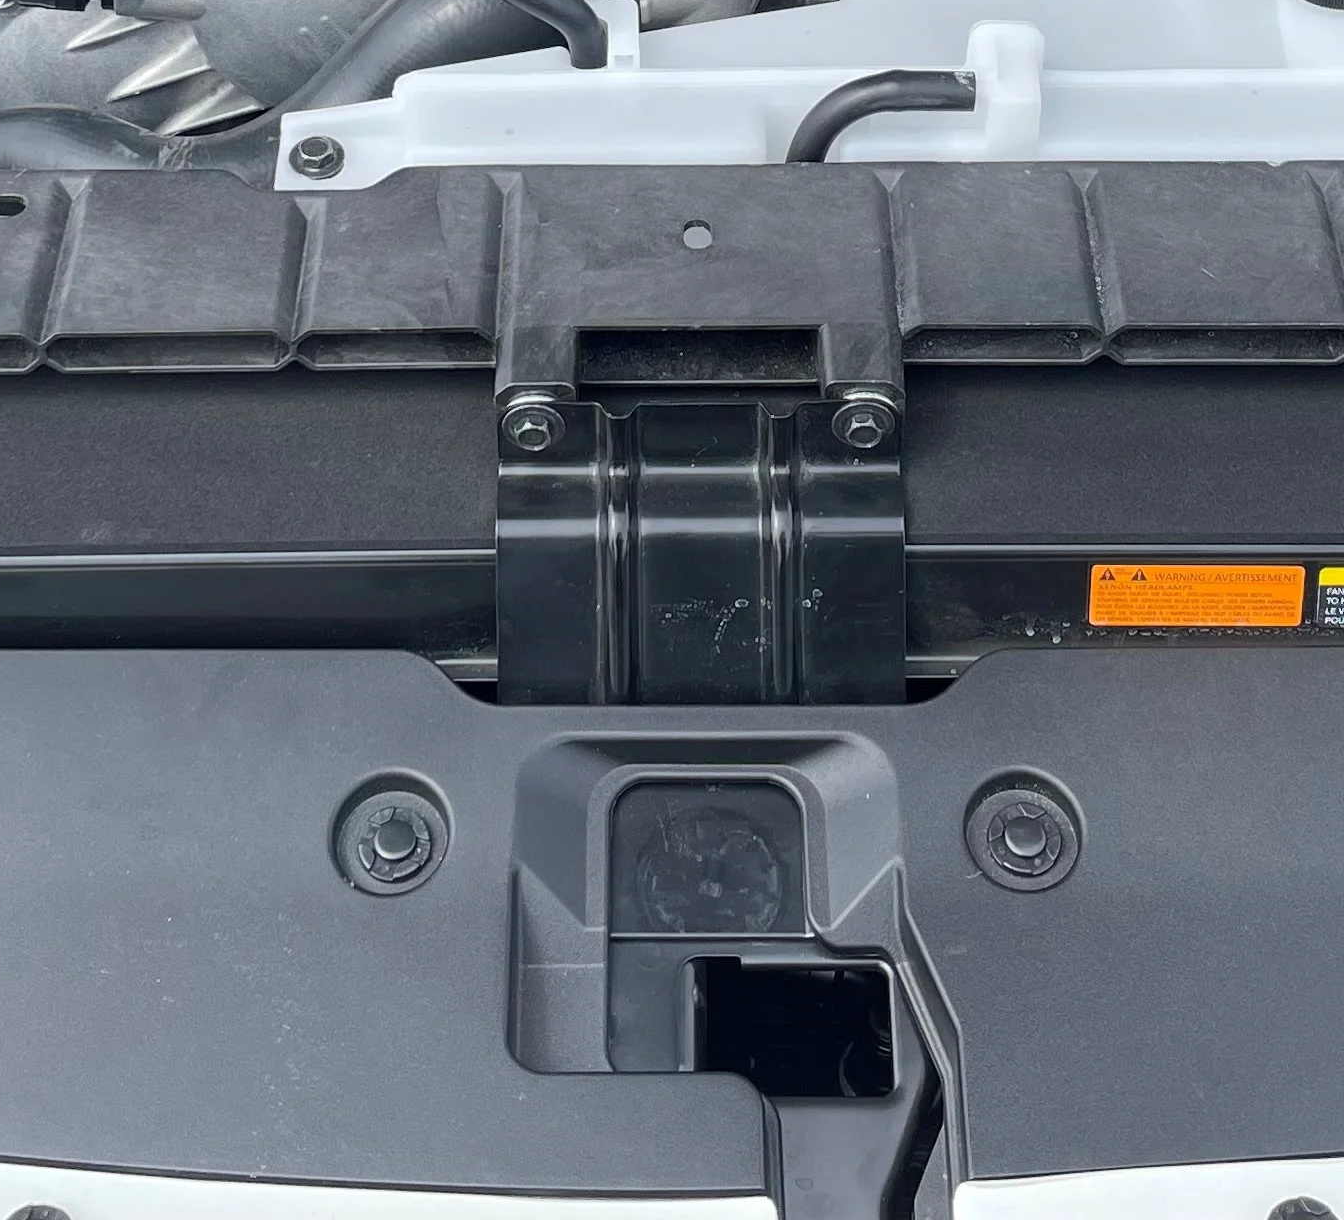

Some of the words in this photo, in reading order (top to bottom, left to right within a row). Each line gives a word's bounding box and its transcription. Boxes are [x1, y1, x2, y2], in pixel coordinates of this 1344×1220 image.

[1154, 572, 1206, 582] WARNING
[1214, 572, 1298, 583] AVERTISSEMENT
[1326, 587, 1344, 596] FAN
[1326, 597, 1339, 605] TO
[1325, 607, 1337, 615] LE
